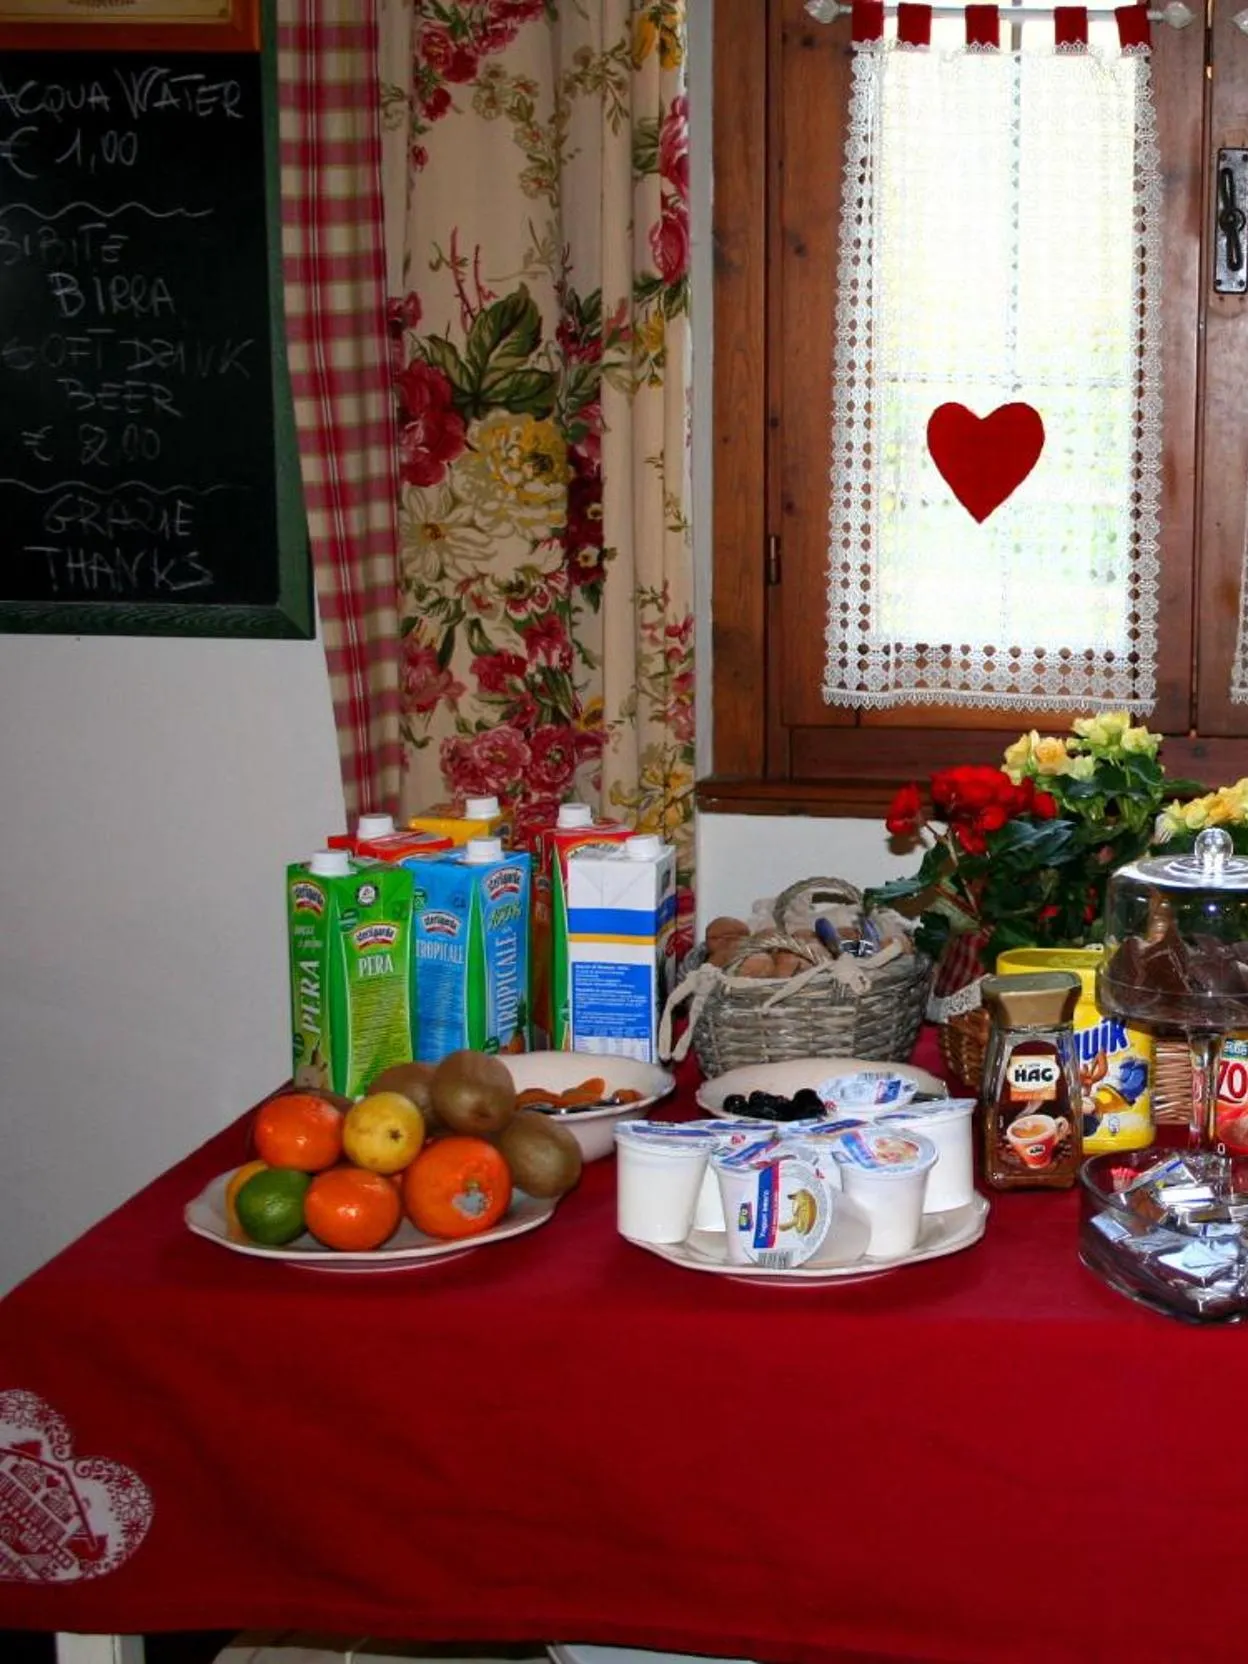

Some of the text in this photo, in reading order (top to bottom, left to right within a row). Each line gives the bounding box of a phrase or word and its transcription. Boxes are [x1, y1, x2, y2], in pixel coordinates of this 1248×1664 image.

[113, 65, 244, 120] WATER
[48, 271, 176, 318] BIRRA
[55, 378, 184, 418] BEER
[23, 546, 215, 592] THANKS
[359, 953, 395, 978] PERA
[297, 960, 321, 1034] PERA
[1014, 1067, 1054, 1083] HAG
